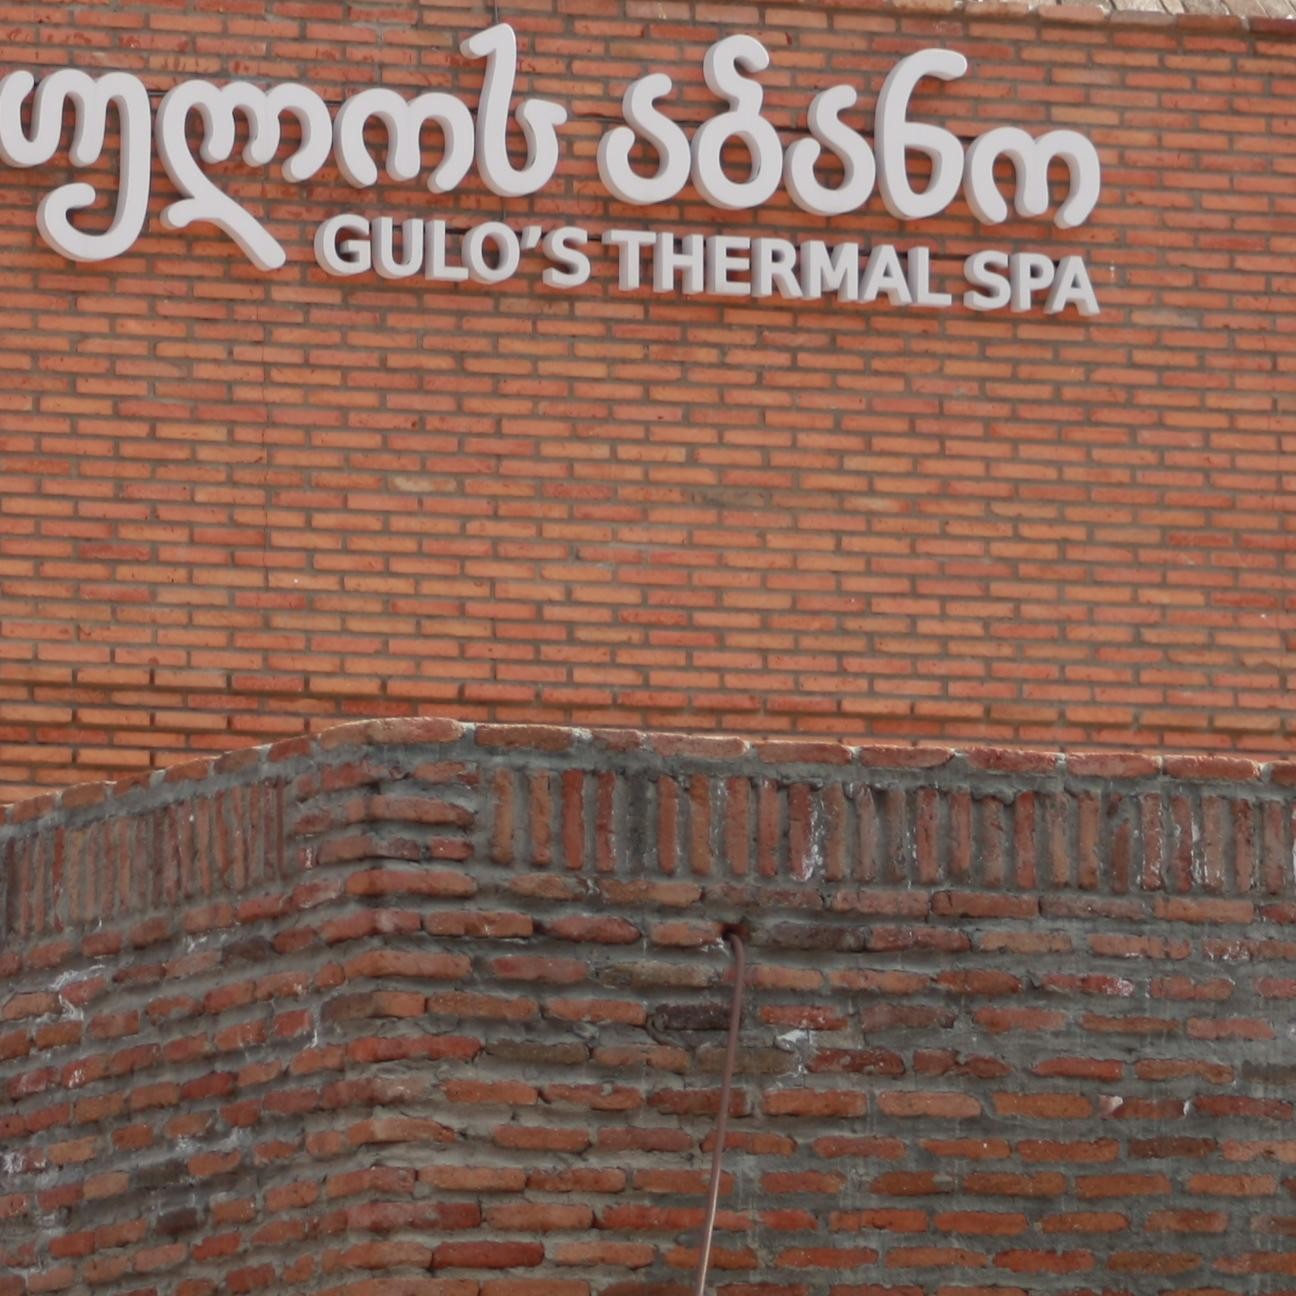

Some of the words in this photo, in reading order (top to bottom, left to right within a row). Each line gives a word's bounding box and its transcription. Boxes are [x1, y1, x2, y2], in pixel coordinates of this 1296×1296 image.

[597, 34, 1102, 230] აბანო
[314, 212, 592, 289] GULO'S
[601, 228, 953, 307] THERMAL
[963, 249, 1102, 317] SPA
